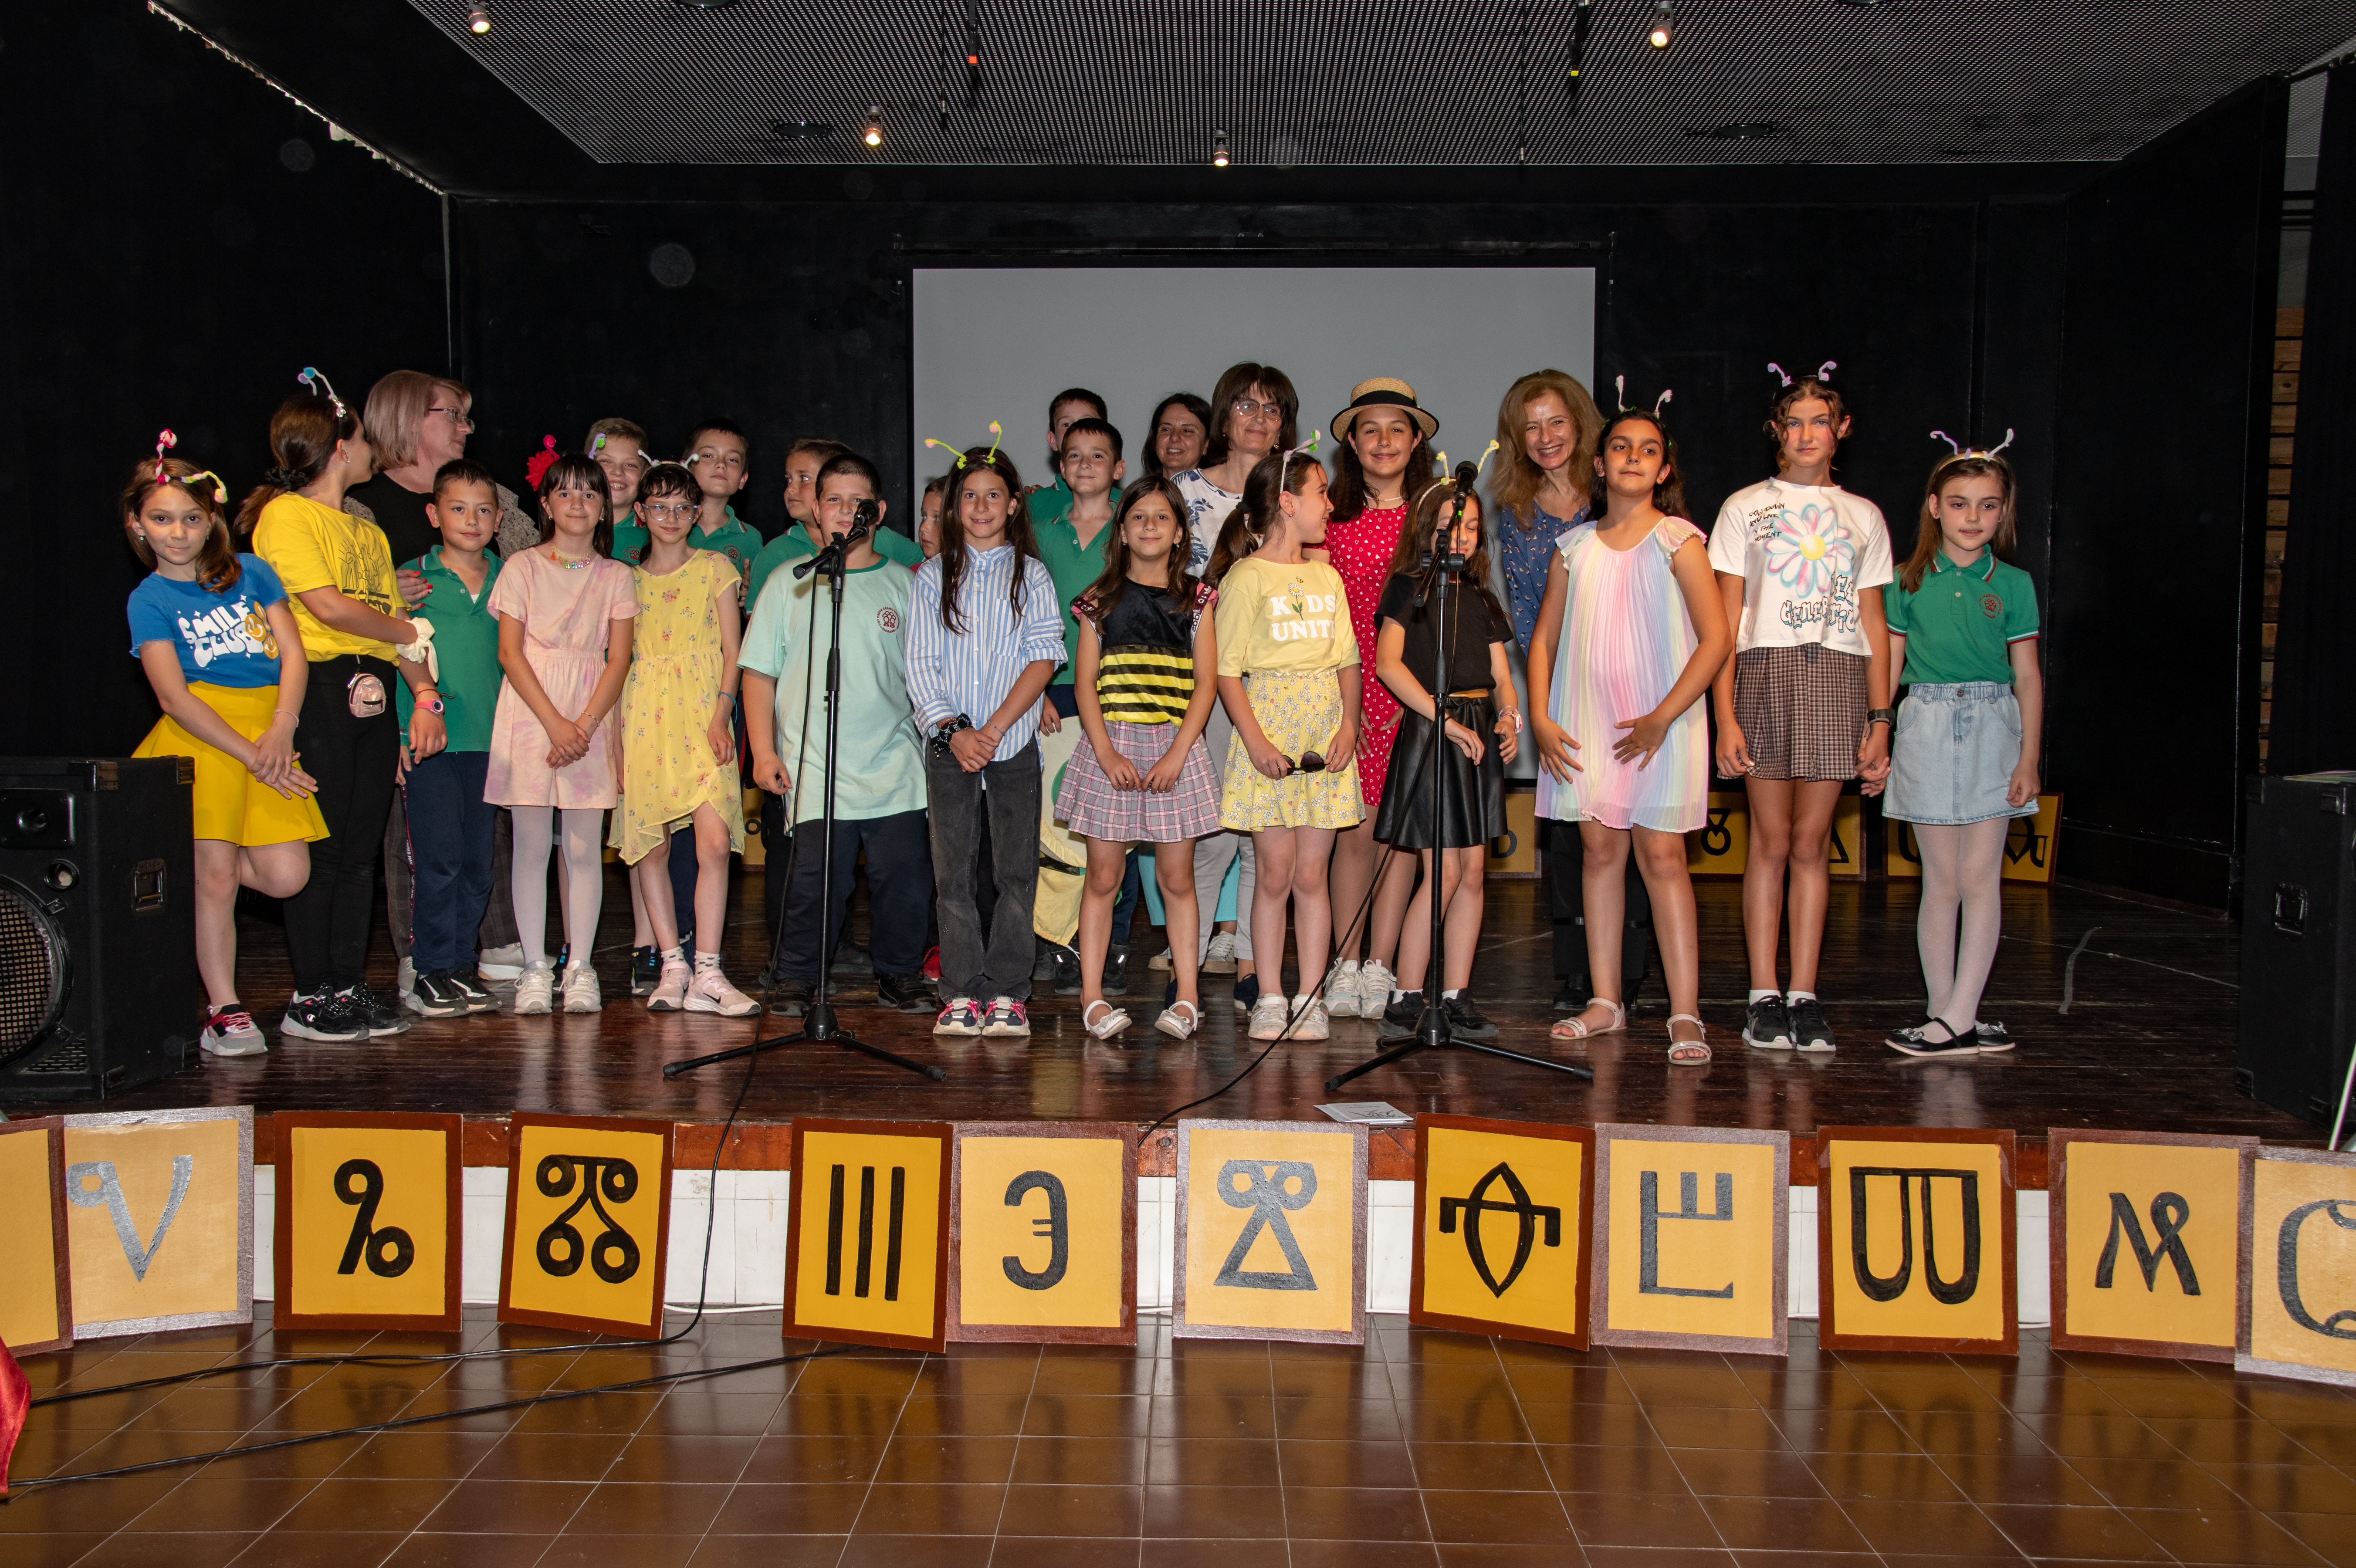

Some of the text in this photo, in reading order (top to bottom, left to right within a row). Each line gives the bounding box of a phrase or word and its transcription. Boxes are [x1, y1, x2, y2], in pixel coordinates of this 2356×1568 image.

[1764, 502, 1784, 511] DOWN
[1750, 516, 1762, 527] AND
[1760, 523, 1774, 531] THE
[194, 622, 264, 667] CLUB
